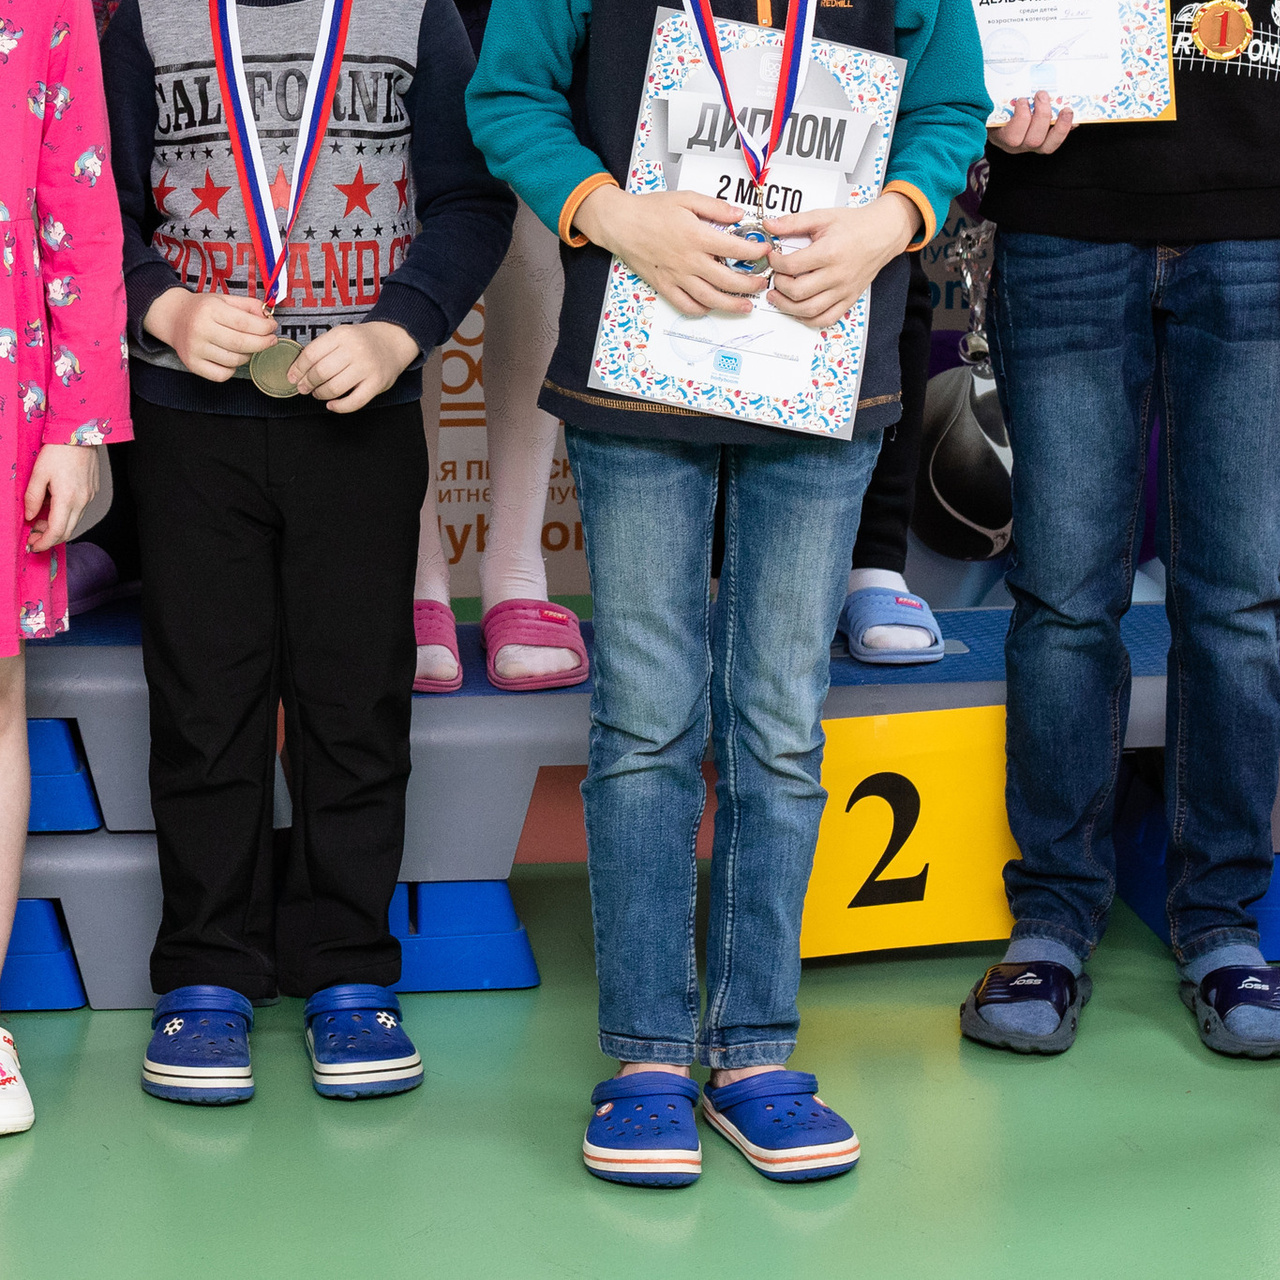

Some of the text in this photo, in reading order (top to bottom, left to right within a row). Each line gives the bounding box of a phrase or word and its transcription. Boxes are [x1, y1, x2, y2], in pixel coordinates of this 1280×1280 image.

[1212, 9, 1232, 48] 1
[154, 69, 406, 135] CALFORNI
[686, 102, 847, 163] ДИПЛОМ
[716, 174, 732, 201] 2
[278, 241, 380, 308] AND
[845, 772, 929, 909] 2
[1009, 978, 1043, 986] JOSS
[1237, 981, 1270, 991] JOSS
